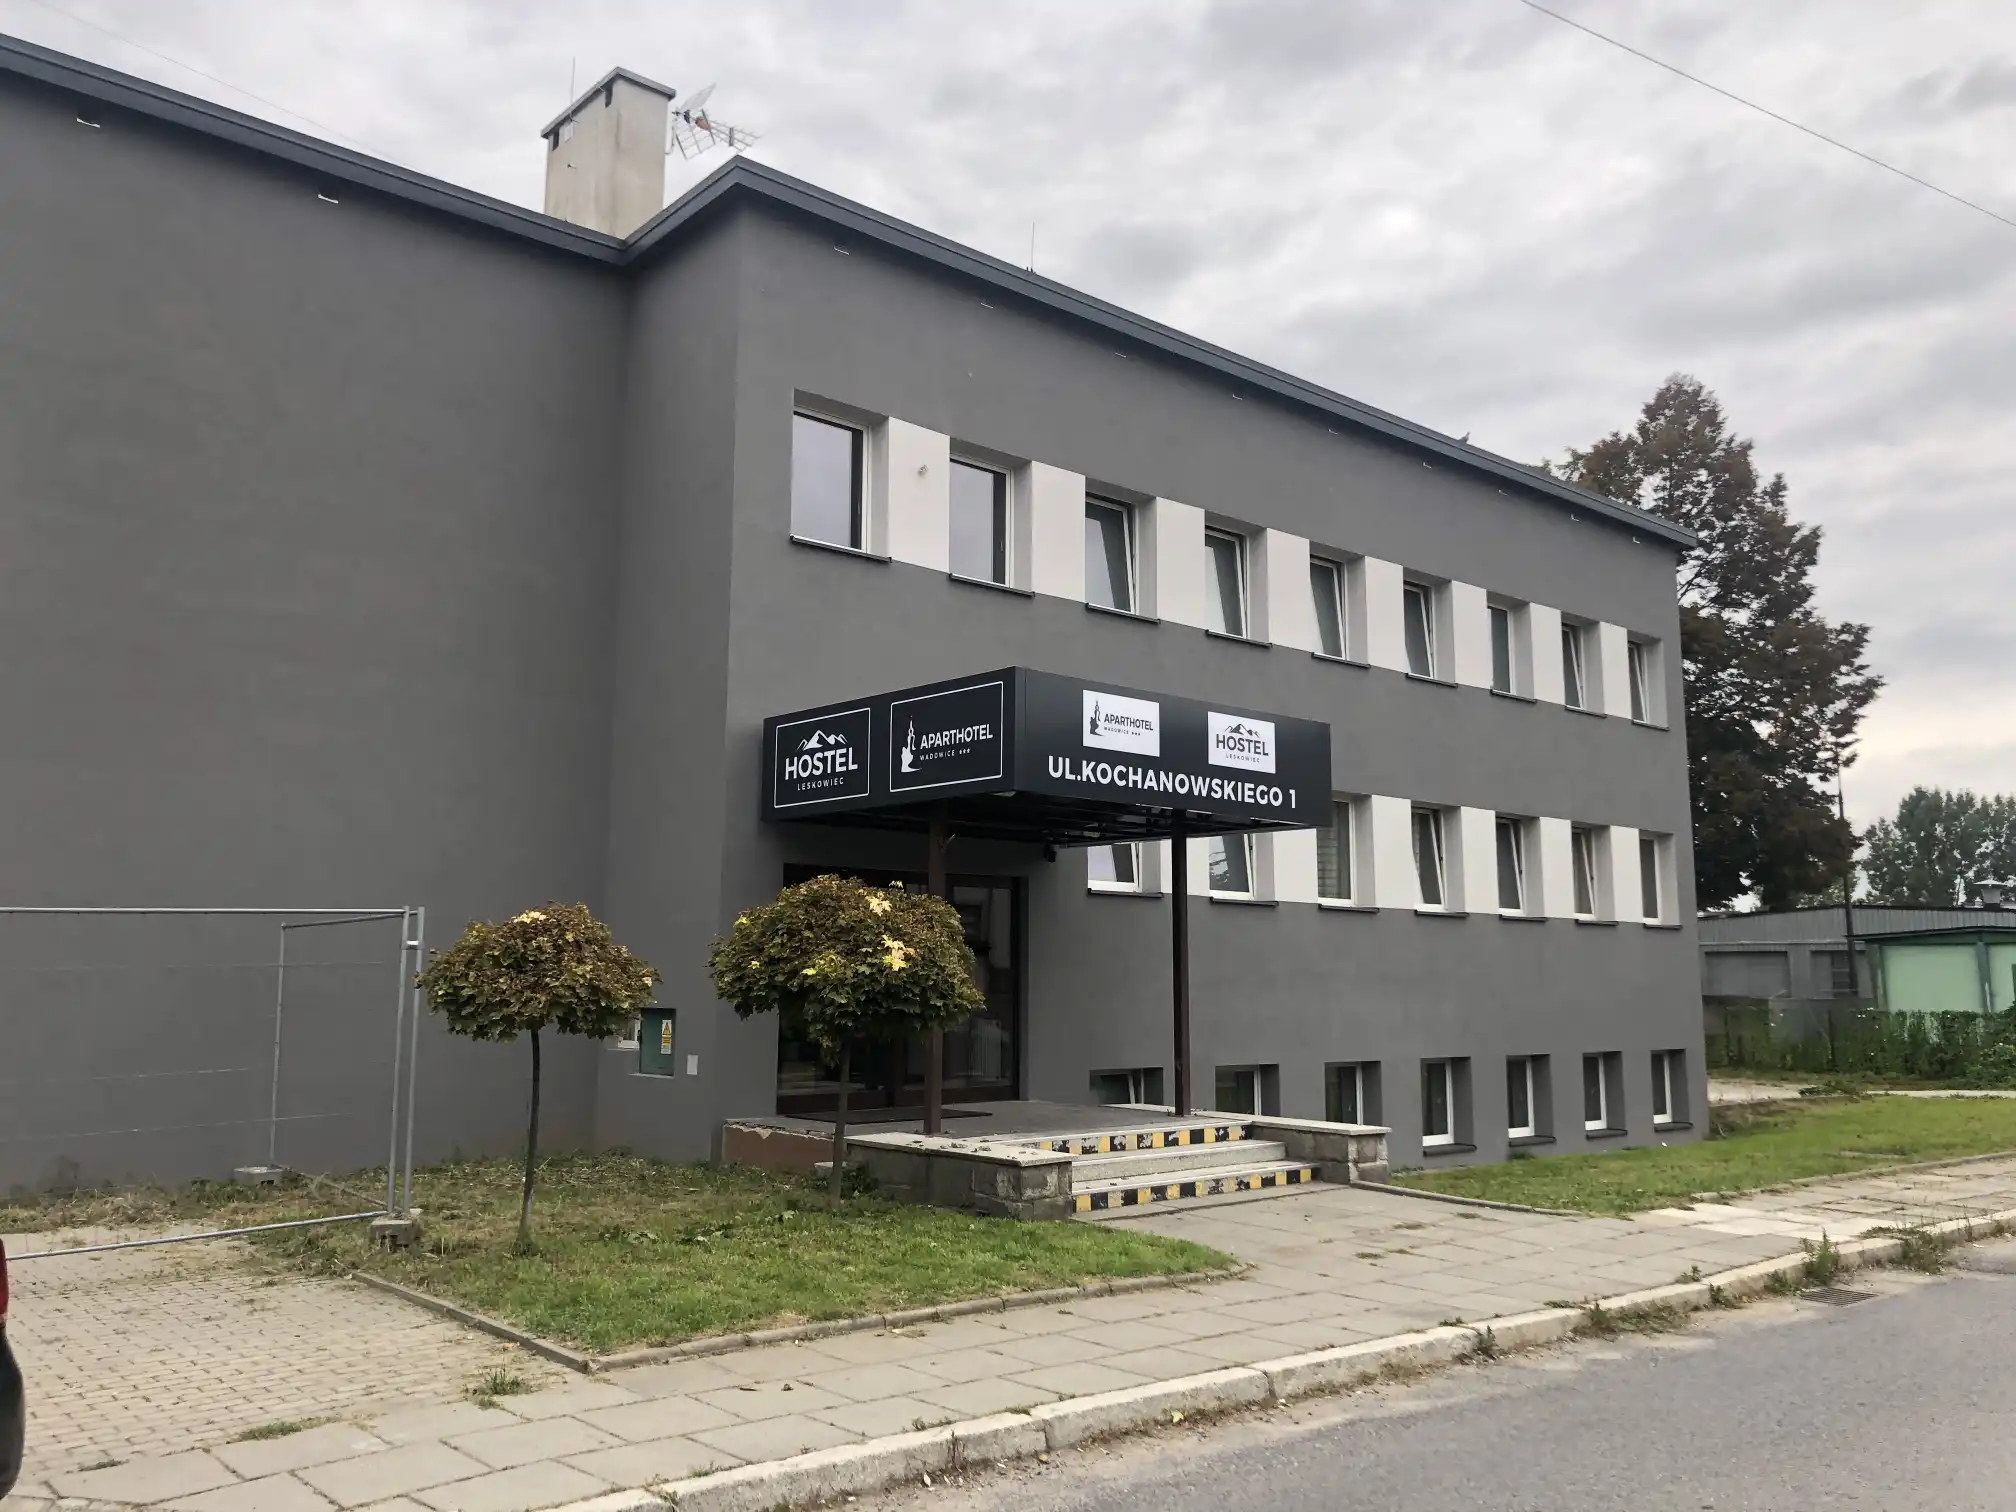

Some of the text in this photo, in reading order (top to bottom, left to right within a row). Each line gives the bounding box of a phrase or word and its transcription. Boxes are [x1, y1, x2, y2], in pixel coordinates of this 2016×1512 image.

[1104, 713, 1153, 731] APARTHOTEL
[920, 723, 993, 749] APARTHOTEL
[1216, 734, 1269, 756] HOSTEL
[785, 747, 858, 780] HOSTEL
[797, 777, 844, 791] LESKOWIEC
[1048, 755, 1297, 809] UL.KOCHANOWSKIEGO 1
